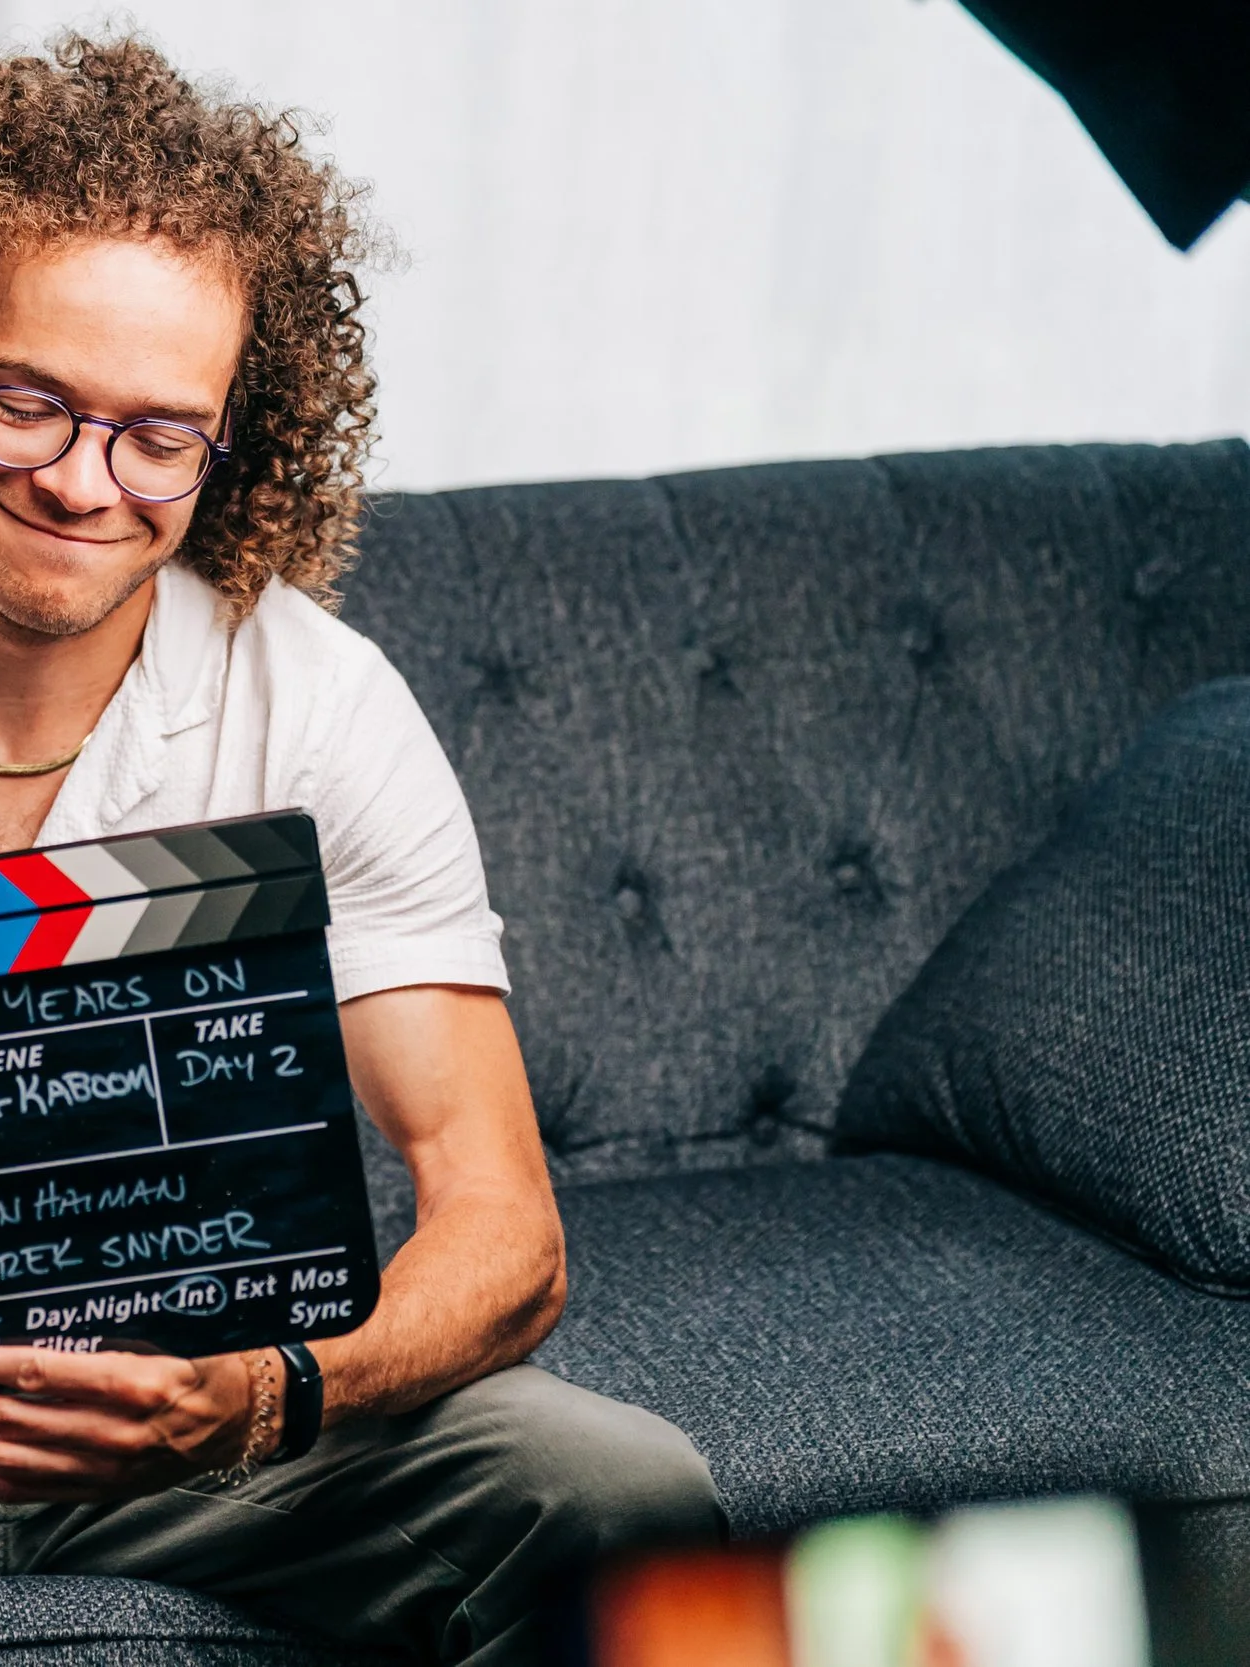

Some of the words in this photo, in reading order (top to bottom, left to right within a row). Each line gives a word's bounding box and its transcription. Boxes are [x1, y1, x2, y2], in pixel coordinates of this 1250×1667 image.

[2, 975, 152, 1023] YEARS
[184, 957, 247, 998] ON
[194, 1012, 265, 1043] TAKE
[176, 1049, 254, 1087] DAY
[270, 1045, 304, 1078] 2
[100, 1210, 271, 1269] SNYDER
[176, 1283, 217, 1309] Int
[234, 1273, 278, 1301] Ext
[290, 1267, 349, 1292] Mos
[290, 1297, 353, 1330] Sync
